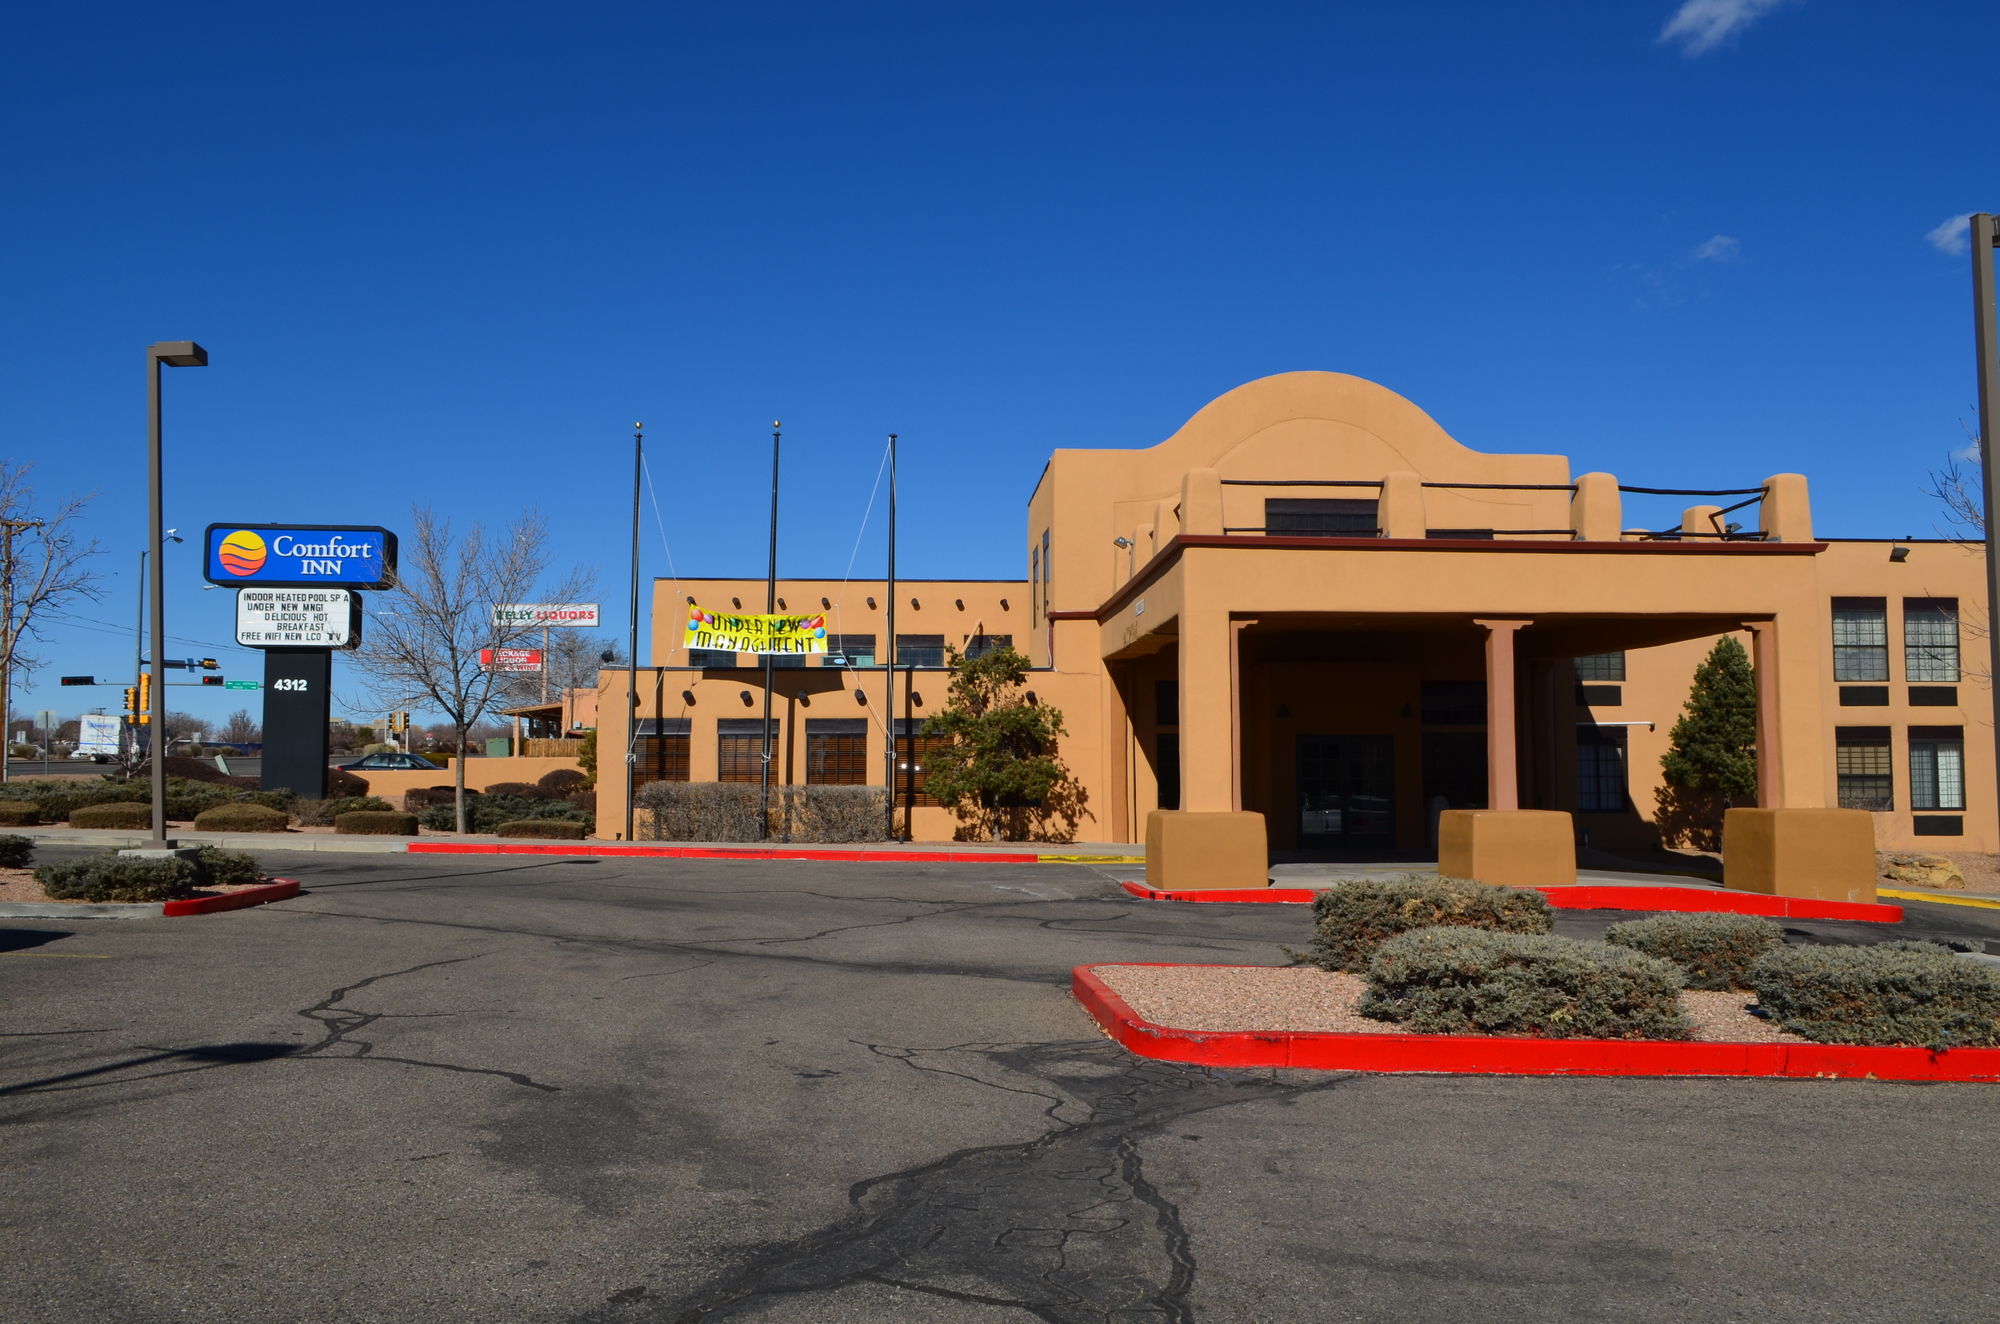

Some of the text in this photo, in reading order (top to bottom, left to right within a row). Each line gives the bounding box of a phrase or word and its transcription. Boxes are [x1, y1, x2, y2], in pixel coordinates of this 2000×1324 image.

[273, 535, 372, 558] Comfort
[301, 559, 342, 575] INN
[243, 593, 274, 601] INDOOR
[275, 593, 307, 602] HEATED
[308, 593, 328, 602] POOL
[247, 603, 275, 611] UNDER
[281, 603, 298, 611] NEW
[314, 613, 328, 621] HOT
[535, 610, 595, 620] LIQUORS
[276, 622, 325, 631] BREAKFAST
[711, 613, 801, 636] UNDER NEW
[241, 632, 261, 640] FREE
[265, 632, 281, 640] WIFI
[285, 632, 302, 640] NEW
[306, 632, 322, 640] LCD
[273, 679, 307, 691] 4312
